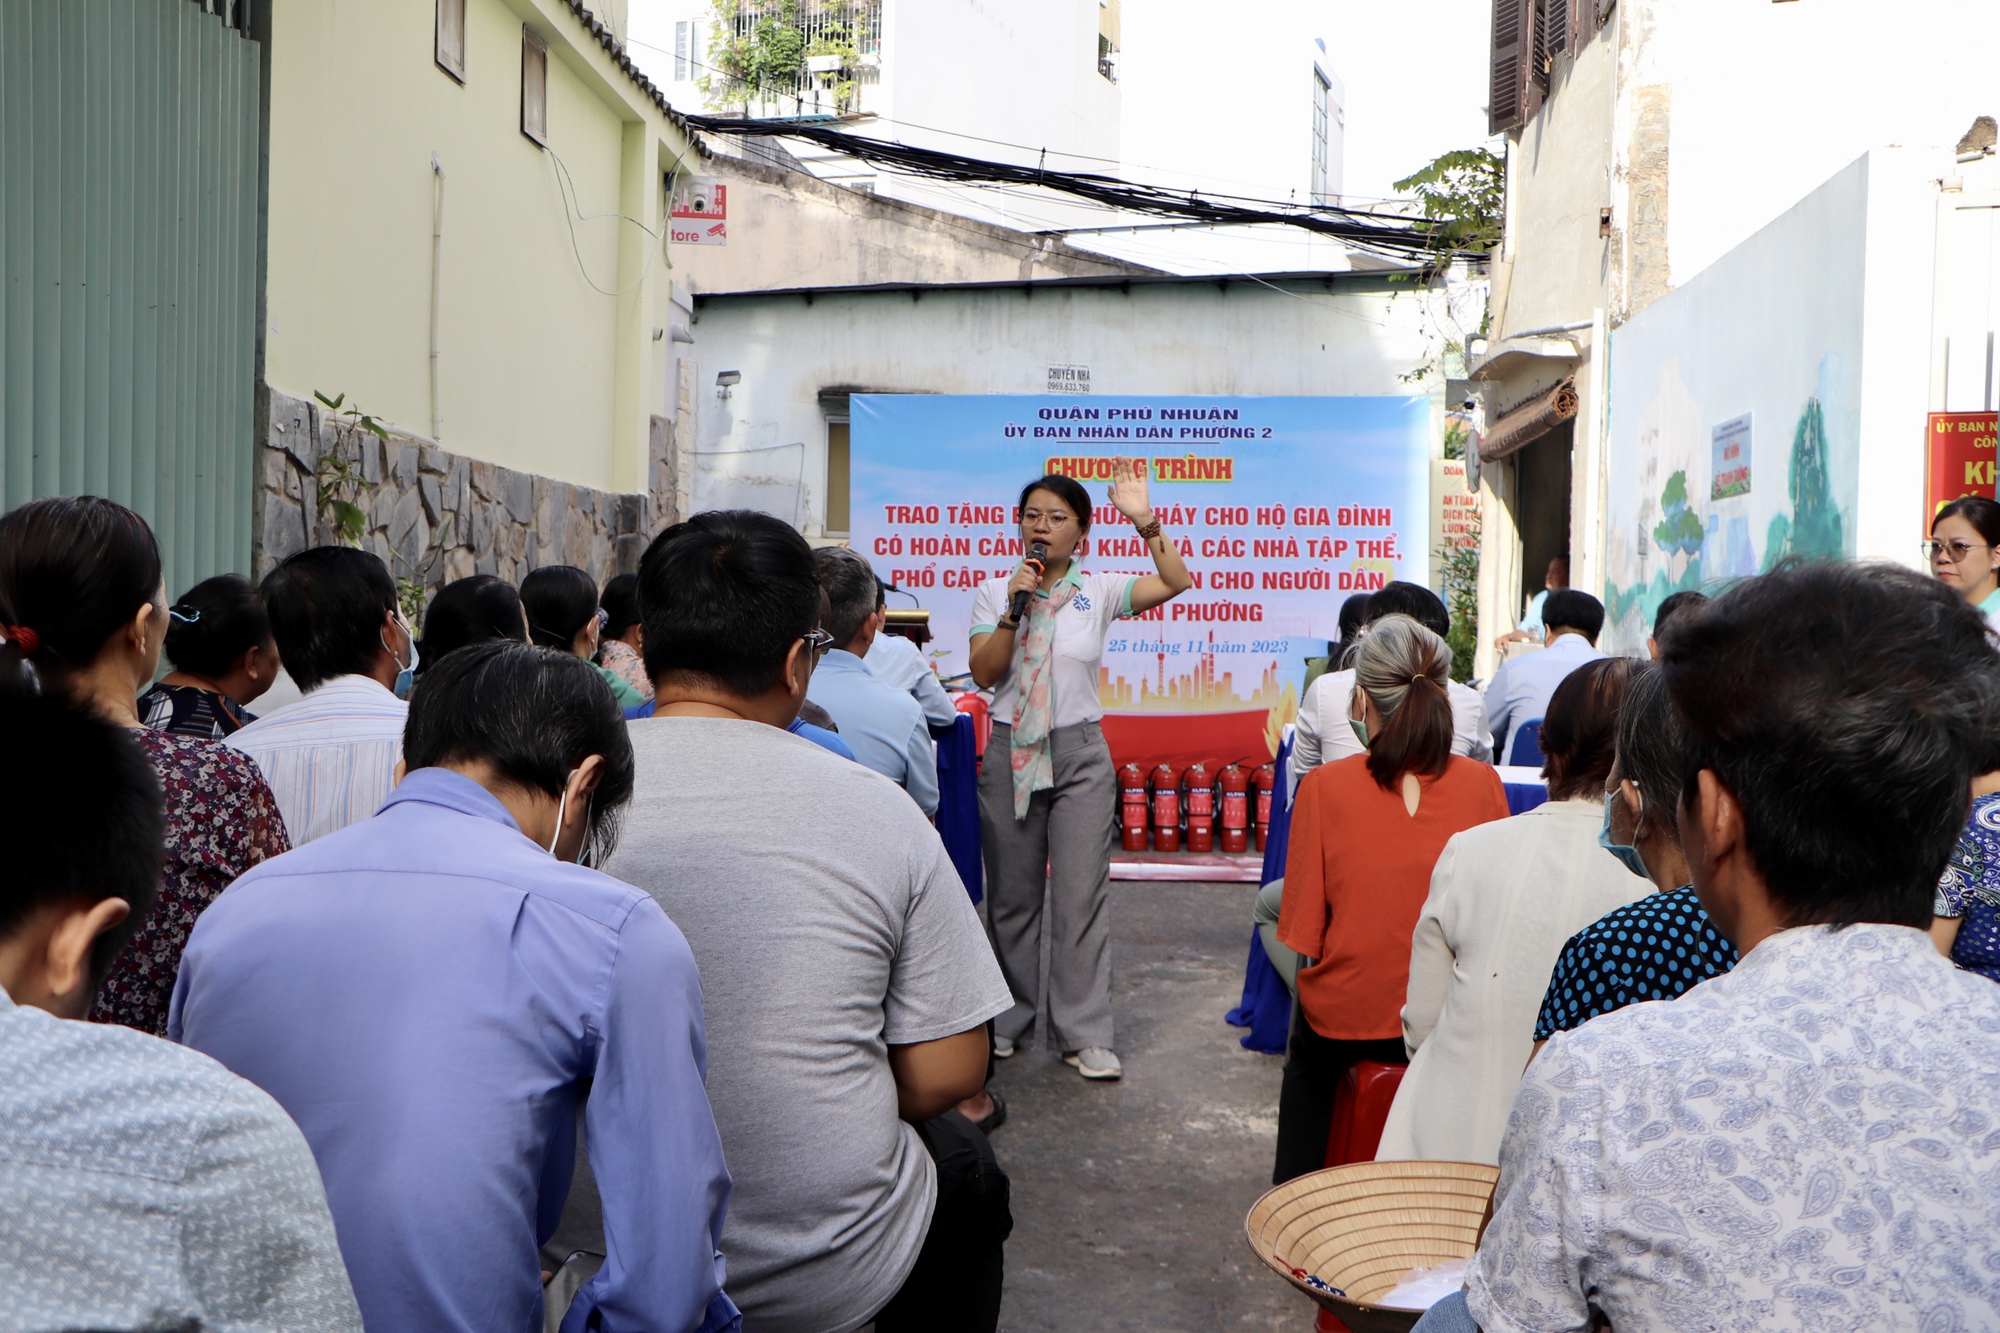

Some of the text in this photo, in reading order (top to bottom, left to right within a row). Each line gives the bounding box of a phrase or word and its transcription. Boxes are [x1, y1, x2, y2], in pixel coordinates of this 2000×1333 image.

[1038, 406, 1239, 423] QUẬN PHÚ NHUẬN
[1936, 418, 1954, 433] ỦY
[1958, 422, 1986, 432] BAN
[1004, 422, 1272, 438] ỦY BAN NHÂN DÂN PHƯỜNG 2
[1046, 454, 1232, 480] CHƯƠG TRÌNH
[885, 506, 940, 524] TRAO
[946, 501, 1004, 528] TẶNG
[1150, 503, 1198, 526] HÁY
[1204, 508, 1249, 526] CHO
[1256, 503, 1286, 530] HỘ
[1294, 508, 1331, 526] GIA
[1338, 503, 1392, 526] ĐÌNH
[874, 534, 905, 556] CÓ
[910, 534, 970, 556] HOÀN
[978, 532, 1023, 556] CẢN
[1202, 534, 1246, 558] CÁC
[1253, 535, 1300, 558] NHÀ
[1306, 536, 1349, 562] TẬP
[1356, 532, 1403, 561] THỂ,
[891, 562, 936, 588] PHỔ
[942, 566, 987, 592] CẬP
[1210, 572, 1254, 590] CHO
[1262, 566, 1331, 590] NGƯỜI
[1172, 600, 1263, 622] PHƯỜNG
[1108, 639, 1289, 656] 25 tháng 11 năm 2023
